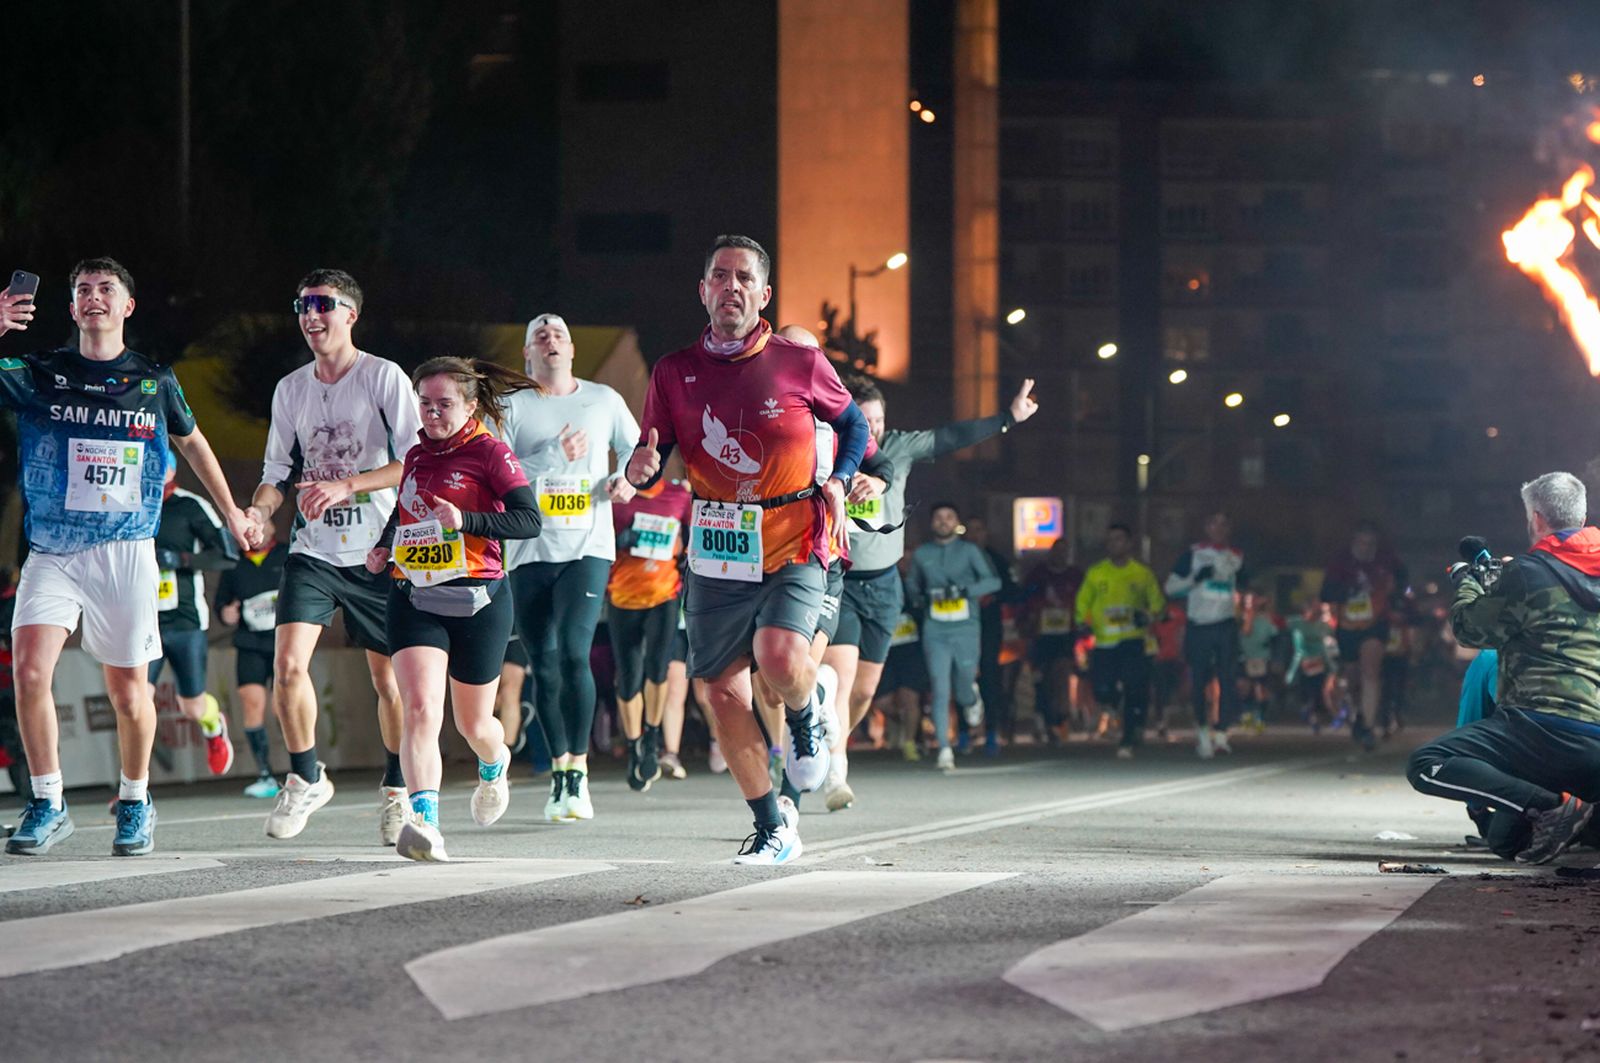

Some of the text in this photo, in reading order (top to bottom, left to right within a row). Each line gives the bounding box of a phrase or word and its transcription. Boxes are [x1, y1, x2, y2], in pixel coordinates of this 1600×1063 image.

[50, 404, 156, 430] SAN ANTÓN
[127, 423, 157, 439] 2025
[76, 454, 91, 463] SAN
[85, 447, 118, 456] NOCHE DE
[720, 443, 741, 465] 43
[84, 464, 126, 487] 4571
[410, 499, 429, 519] 43
[548, 494, 586, 511] 7036
[844, 500, 874, 515] 394
[323, 506, 362, 527] 4571
[698, 518, 712, 527] SAN
[707, 511, 726, 519] NOCHE
[726, 512, 736, 520] DE
[402, 538, 417, 546] SAN
[702, 528, 750, 555] 8003
[404, 543, 454, 564] 2330
